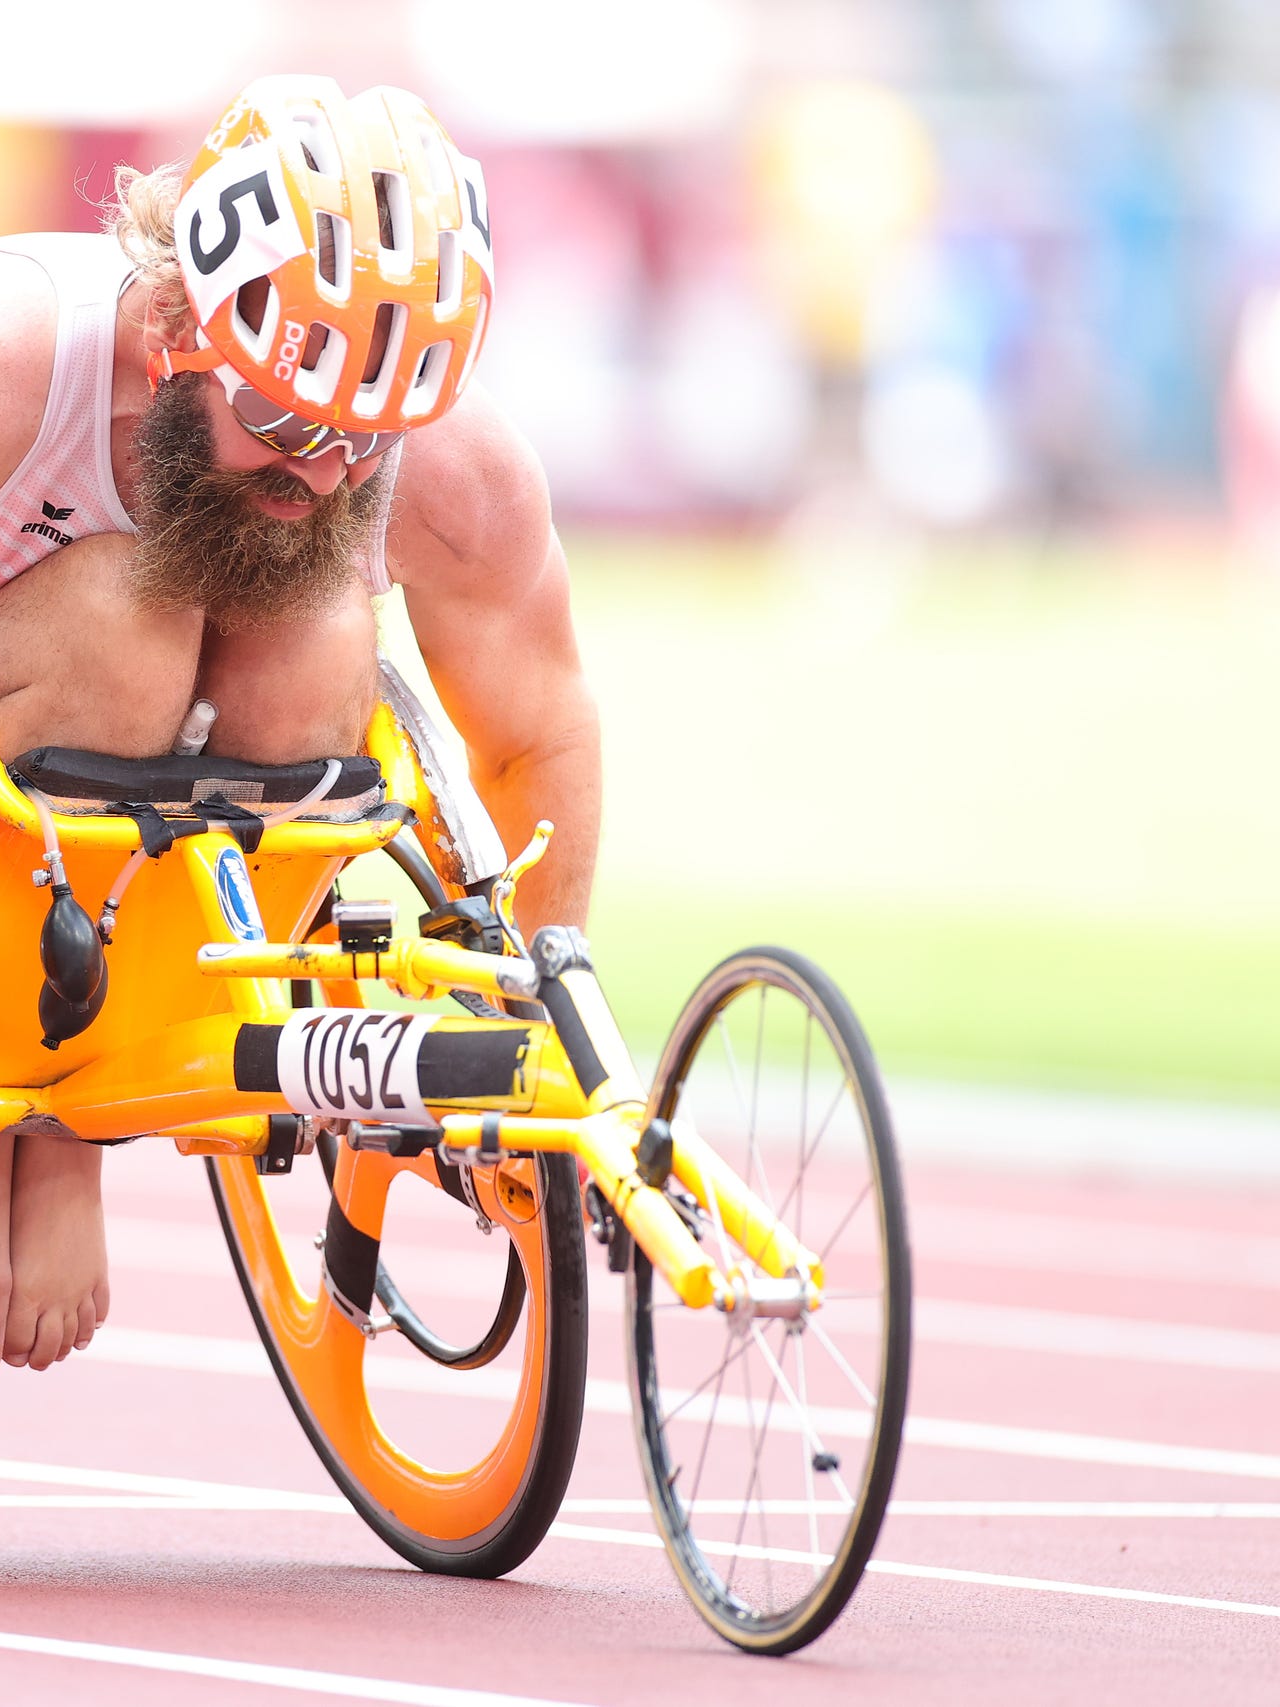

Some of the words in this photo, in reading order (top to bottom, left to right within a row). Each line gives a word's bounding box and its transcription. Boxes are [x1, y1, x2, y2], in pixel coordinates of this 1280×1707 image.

[189, 170, 280, 275] 5
[21, 521, 73, 546] erima
[300, 1014, 415, 1110] 1052
